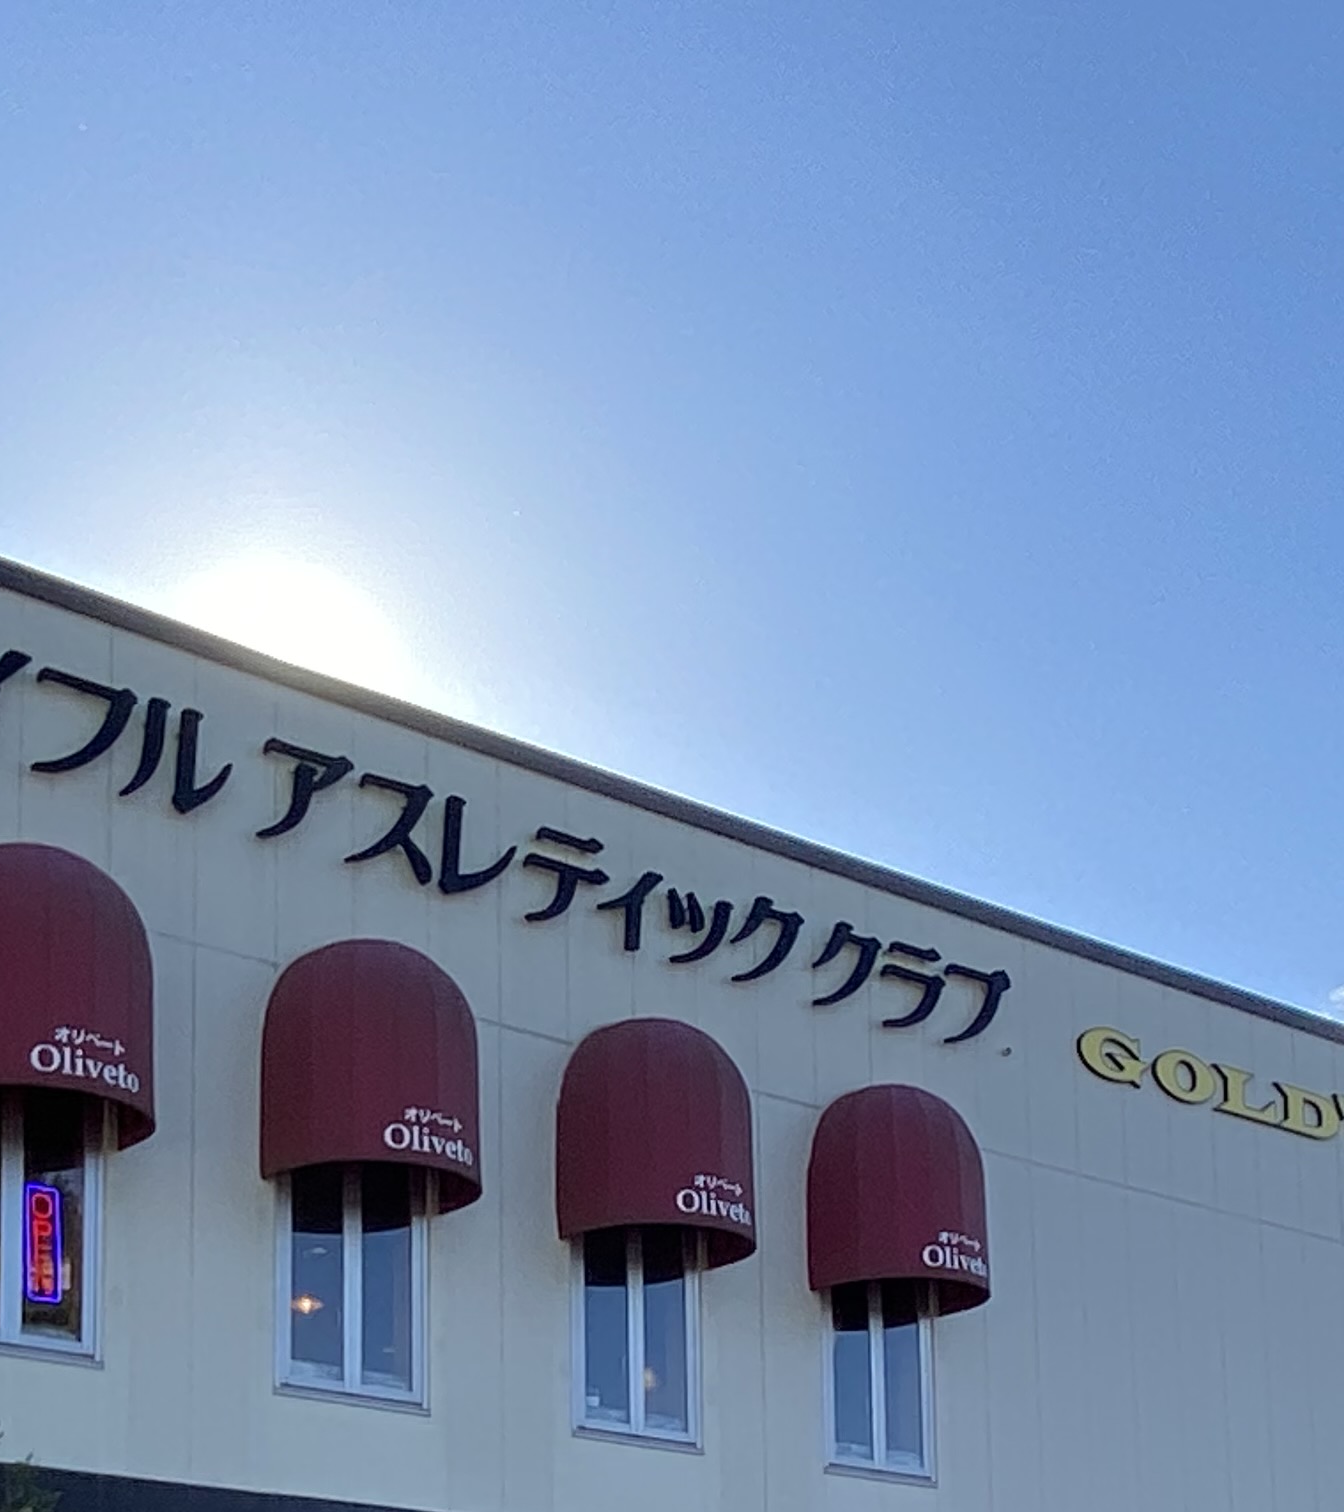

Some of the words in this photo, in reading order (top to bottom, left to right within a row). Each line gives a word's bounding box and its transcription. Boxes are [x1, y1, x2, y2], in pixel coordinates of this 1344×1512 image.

[54, 1025, 126, 1058] オリベート
[29, 1043, 140, 1095] Oliveto
[383, 1122, 474, 1167] Oliveto
